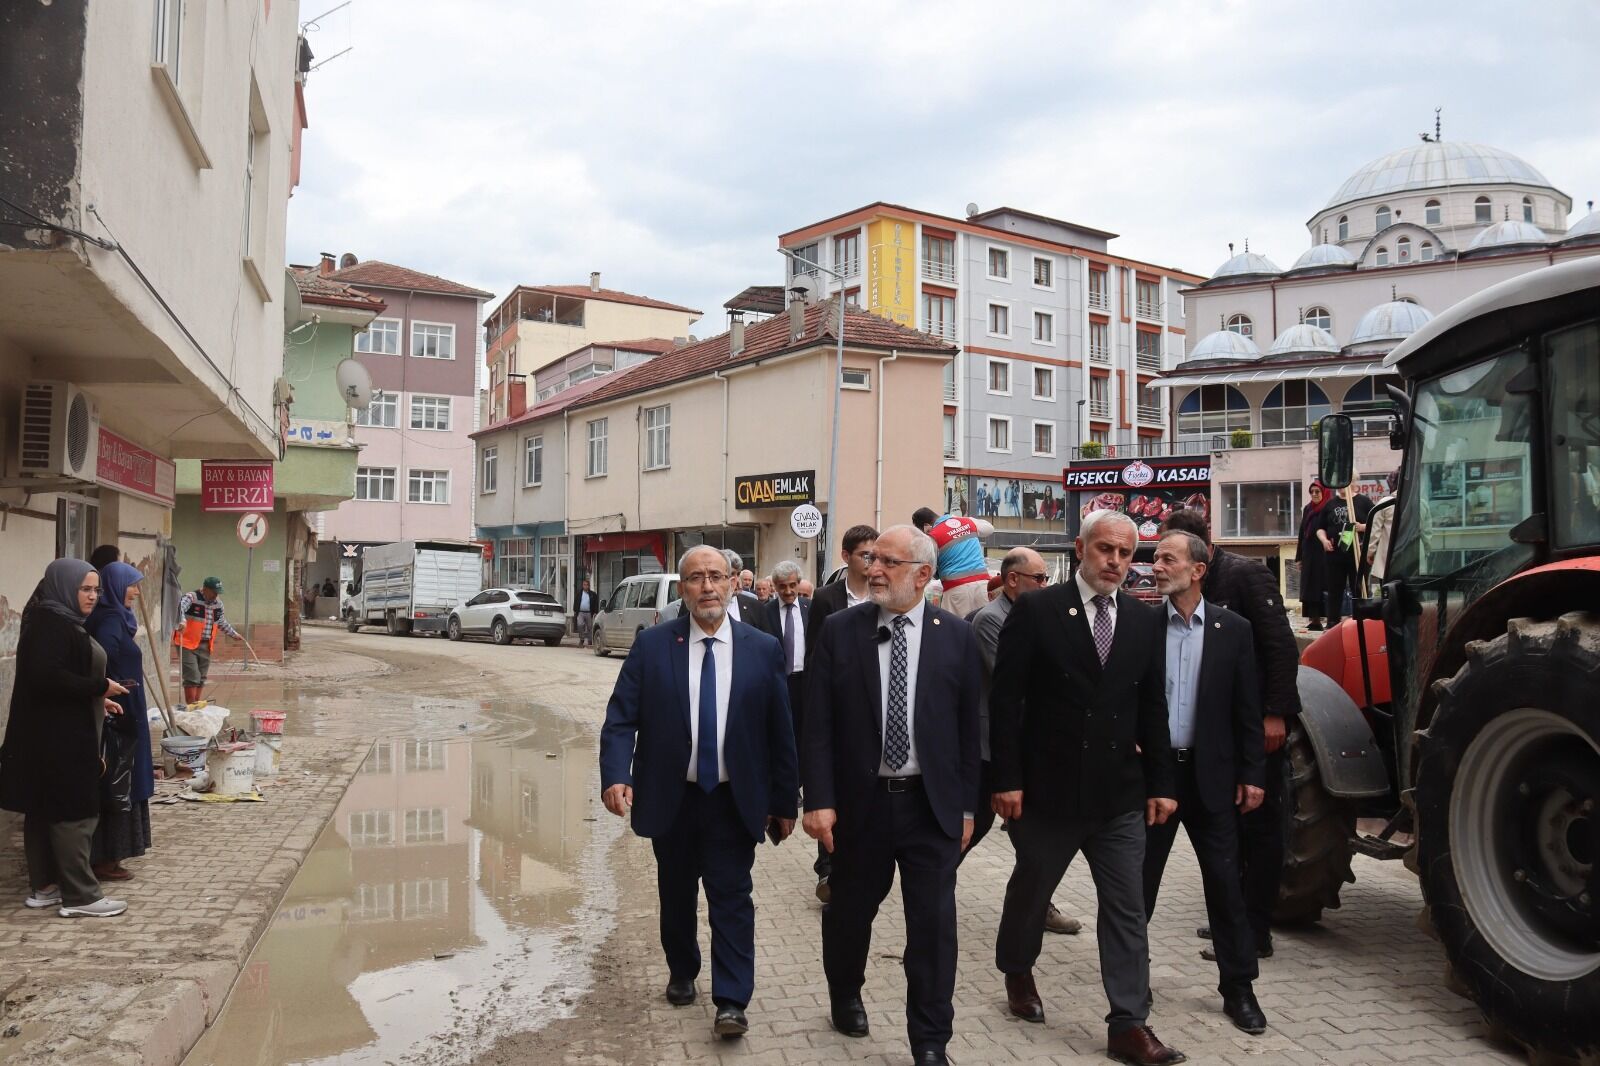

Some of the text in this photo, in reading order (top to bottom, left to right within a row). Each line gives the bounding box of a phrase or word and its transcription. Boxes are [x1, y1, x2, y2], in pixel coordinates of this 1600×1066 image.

[205, 469, 270, 482] BAY & BAYAN
[208, 483, 268, 504] TERZİ
[775, 477, 808, 494] EMLAK
